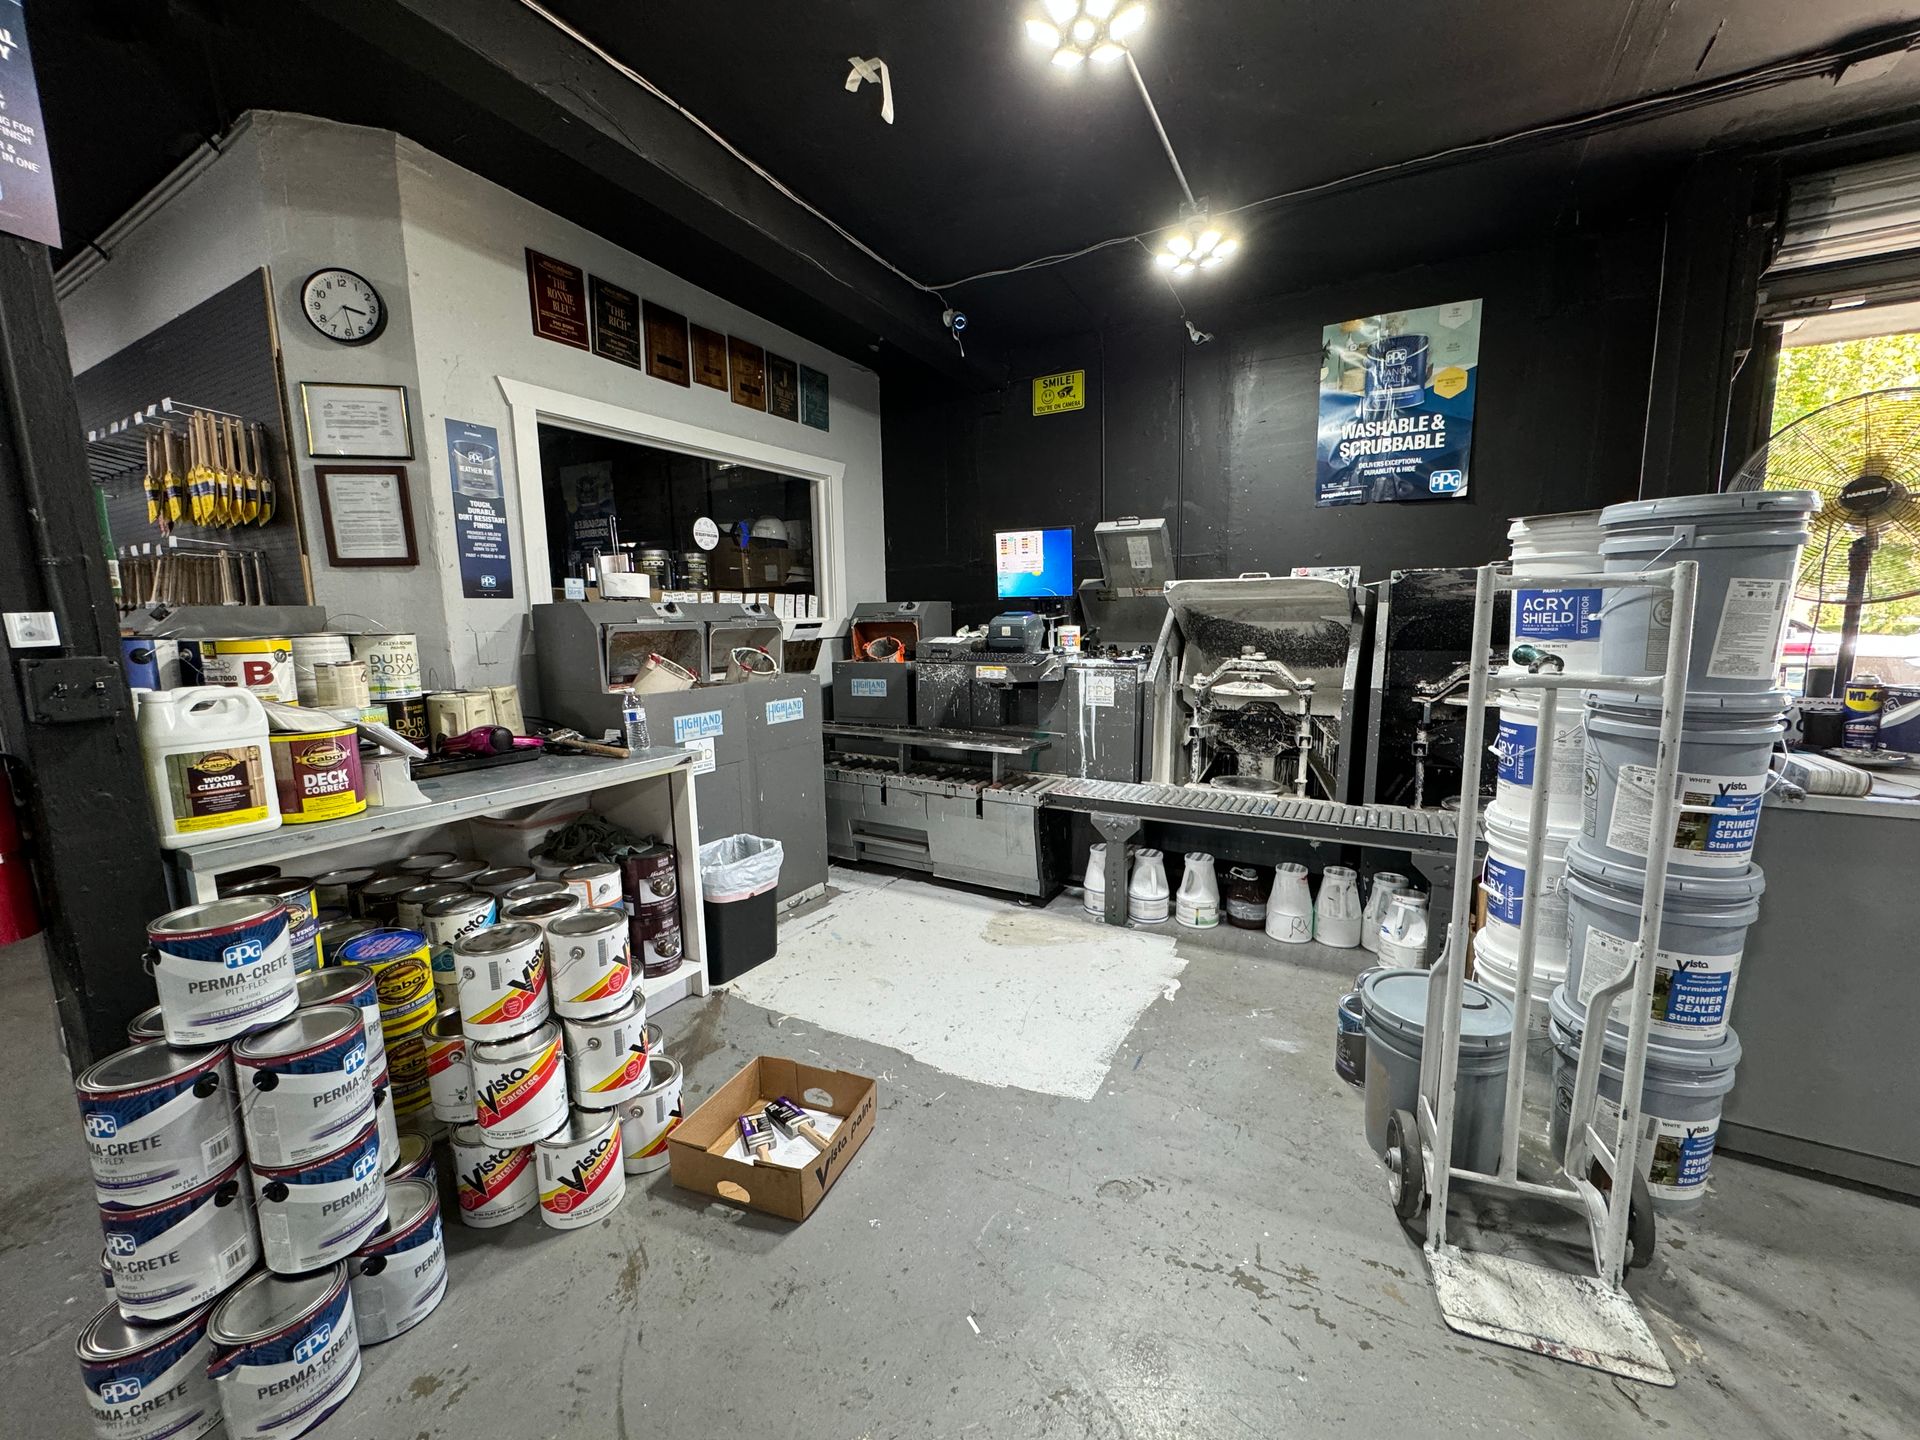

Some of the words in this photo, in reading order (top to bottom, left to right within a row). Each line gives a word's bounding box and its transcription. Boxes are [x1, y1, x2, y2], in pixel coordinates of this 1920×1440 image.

[12, 120, 36, 137] FOR
[16, 158, 41, 174] ONE
[326, 281, 332, 290] 11
[337, 279, 347, 287] 12
[354, 283, 358, 292] 1
[316, 290, 326, 299] 10
[364, 293, 371, 302] 2
[313, 301, 321, 311] 9
[369, 305, 376, 314] 3
[320, 314, 327, 323] 8
[366, 318, 374, 326] 4
[330, 324, 337, 332] 7
[344, 328, 352, 337] 6
[358, 326, 366, 335] 5
[1386, 350, 1407, 366] PPG
[1042, 375, 1075, 389] SMILE!
[1062, 400, 1081, 408] CAMERA
[1341, 415, 1430, 440] WASHABLE
[1431, 413, 1446, 430] &
[1340, 432, 1446, 459] SCRUBBABLE
[1359, 461, 1384, 469] DELIVERS
[1385, 457, 1423, 466] EXCEPTIONAL
[1364, 466, 1395, 476] DURABILITY
[1402, 465, 1416, 473] HIDE
[1431, 470, 1461, 490] PPG
[1846, 486, 1888, 499] MASTER
[467, 507, 496, 516] DURABLE
[481, 576, 497, 588] PPG
[1523, 597, 1574, 611] ACRY
[1522, 612, 1574, 624] SHIELD
[1580, 595, 1589, 634] EXTERIOR
[370, 653, 414, 665] DURA
[243, 661, 274, 687] B
[371, 664, 414, 676] POXY
[853, 680, 886, 695] HIGHLAND
[767, 699, 803, 723] HIGHLAND
[675, 712, 722, 740] HIGHLAND
[201, 760, 233, 769] Cabot
[306, 752, 345, 763] Cabot
[197, 779, 243, 791] CLEANER
[203, 774, 236, 784] WOOD
[303, 769, 349, 788] DECK
[305, 782, 349, 795] CORRECT
[1718, 782, 1747, 799] Vista
[1717, 818, 1756, 829] PRIMER
[1714, 829, 1753, 839] SEALER
[1708, 840, 1735, 849] Stain
[1507, 885, 1515, 919] EXTERIOR
[289, 914, 305, 923] bot
[224, 943, 262, 967] PPG
[188, 953, 288, 994] PERMA-CRETE
[1676, 960, 1709, 974] Vista
[225, 977, 270, 997] PITT-FLEX
[376, 973, 427, 996] Cabot
[1675, 984, 1721, 993] Terminator
[210, 988, 285, 1018] INTERIOR/EXTERIOR
[1677, 994, 1723, 1005] PRIMER
[1675, 1003, 1721, 1014] SEALER
[1668, 1013, 1697, 1023] Stain
[1699, 1015, 1721, 1024] Killer
[477, 1067, 529, 1117] Vista
[500, 1074, 541, 1105] Carefree
[86, 1117, 115, 1137] PPG
[1686, 1125, 1710, 1139] Vista
[815, 1135, 848, 1191] Vista
[850, 1097, 872, 1139] paint
[355, 1151, 377, 1179] PPG
[557, 1138, 612, 1194] Vista
[588, 1141, 617, 1181] Carefree
[461, 1148, 516, 1197] Vista
[107, 1236, 134, 1255] PPG
[295, 1328, 330, 1361] PPG
[257, 1320, 353, 1401] PERMA-CRETE
[102, 1382, 140, 1403] PPG
